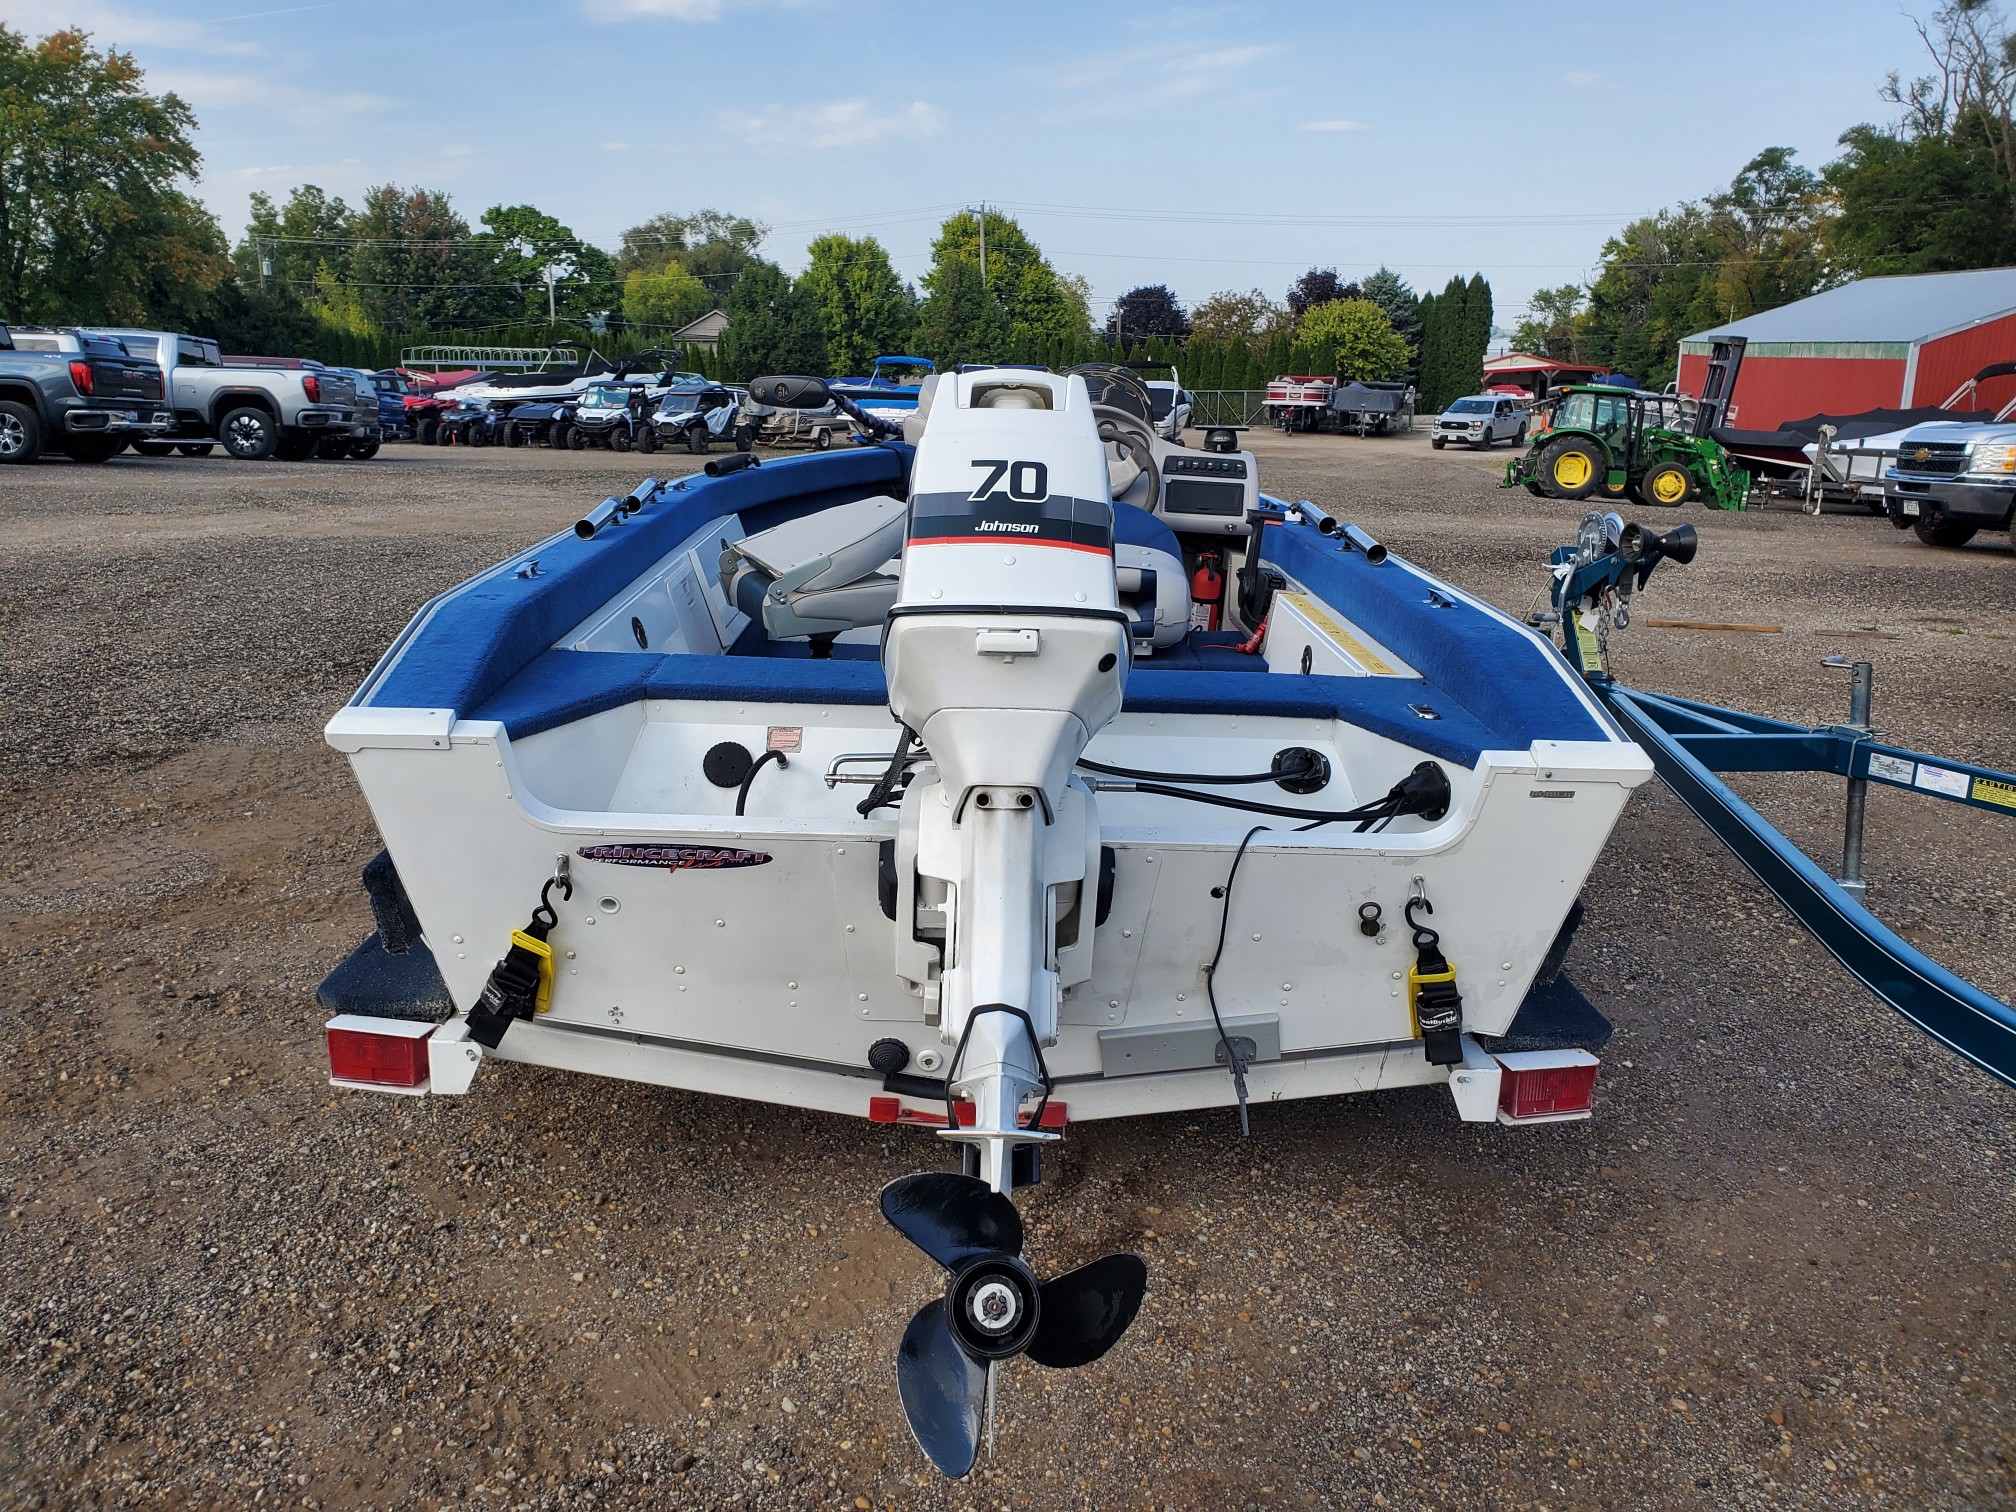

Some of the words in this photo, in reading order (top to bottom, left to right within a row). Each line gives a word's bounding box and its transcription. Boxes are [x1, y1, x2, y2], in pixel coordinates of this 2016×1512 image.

[967, 459, 1049, 503] 70
[974, 520, 1039, 534] Johnson
[1975, 777, 2016, 792] CAUTIO
[591, 857, 686, 866] PERFORMANCE
